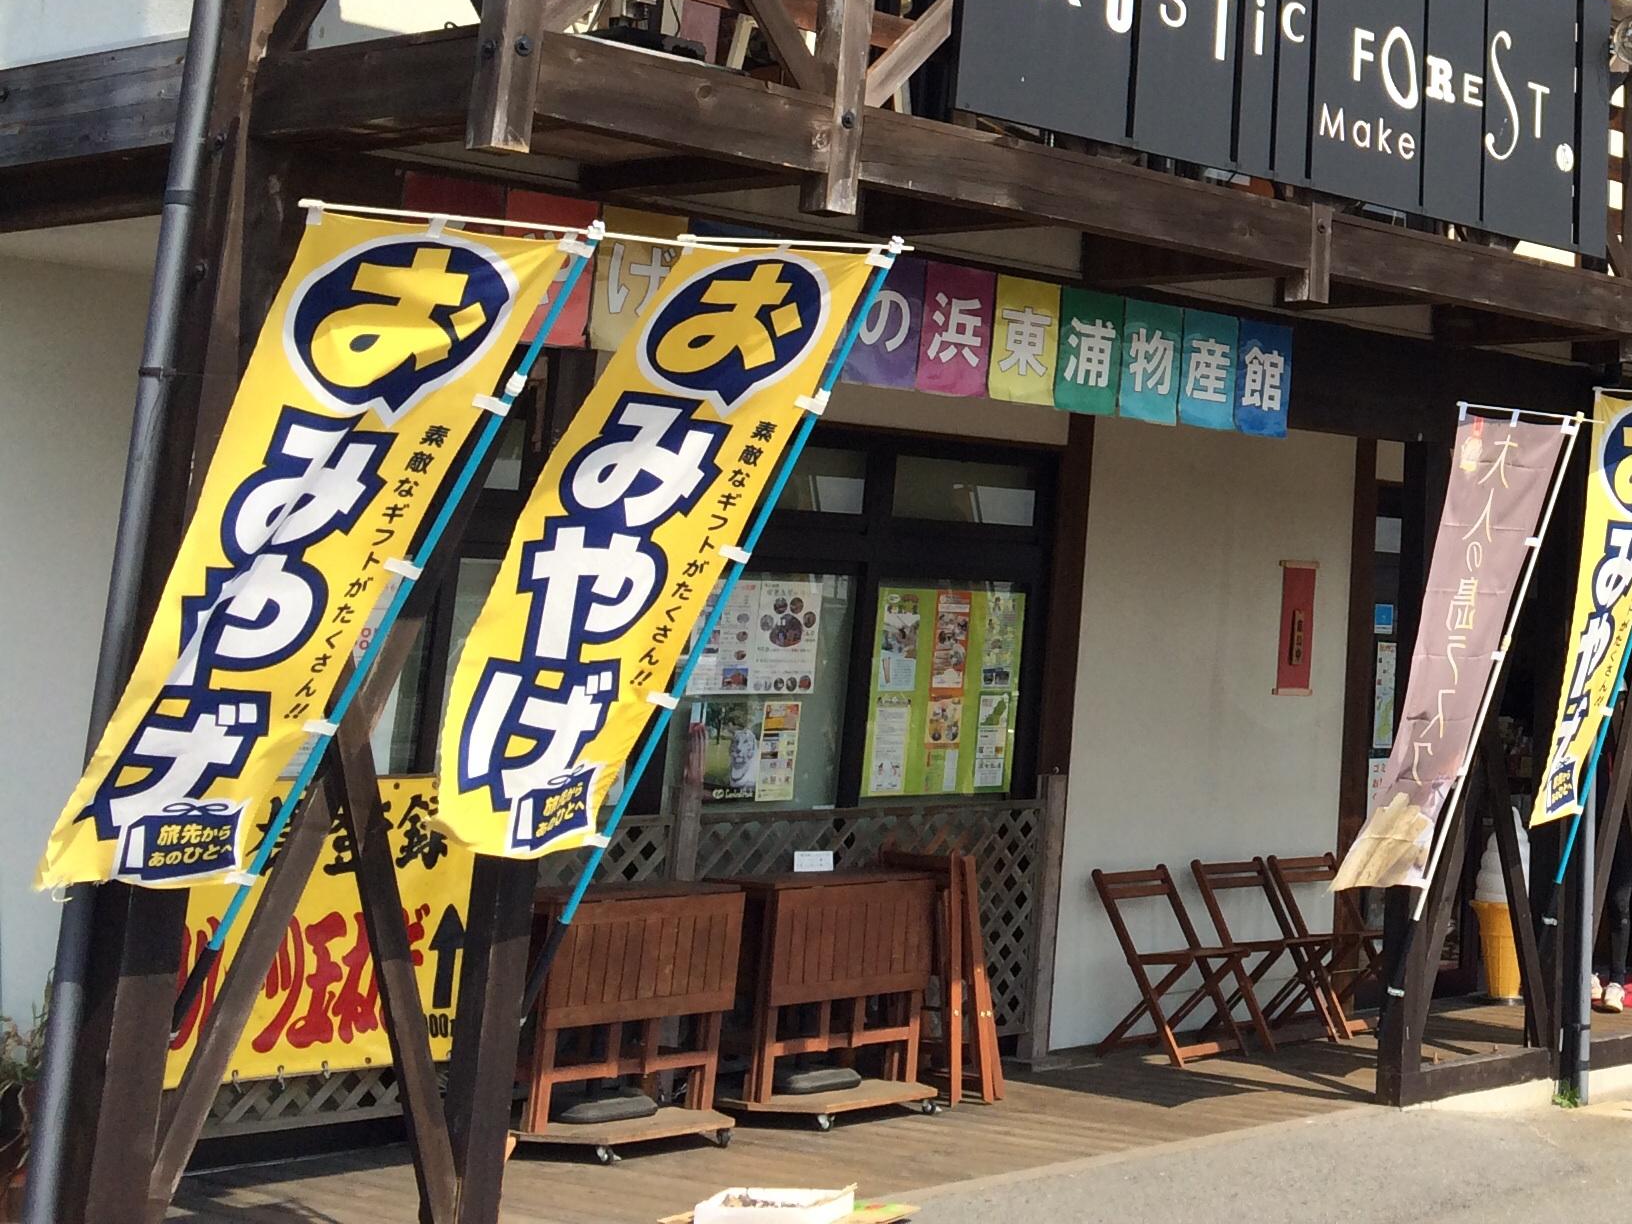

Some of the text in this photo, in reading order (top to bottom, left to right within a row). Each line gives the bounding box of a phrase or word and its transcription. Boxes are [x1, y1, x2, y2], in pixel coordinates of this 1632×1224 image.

[1319, 102, 1417, 161] Make
[858, 289, 1285, 411] の浜東浦物産館
[466, 262, 803, 798] おみやげ
[629, 420, 778, 688] 素敵なギフトがたくさん!!
[147, 843, 234, 868] あのひとへ
[156, 822, 232, 846] 旅先から
